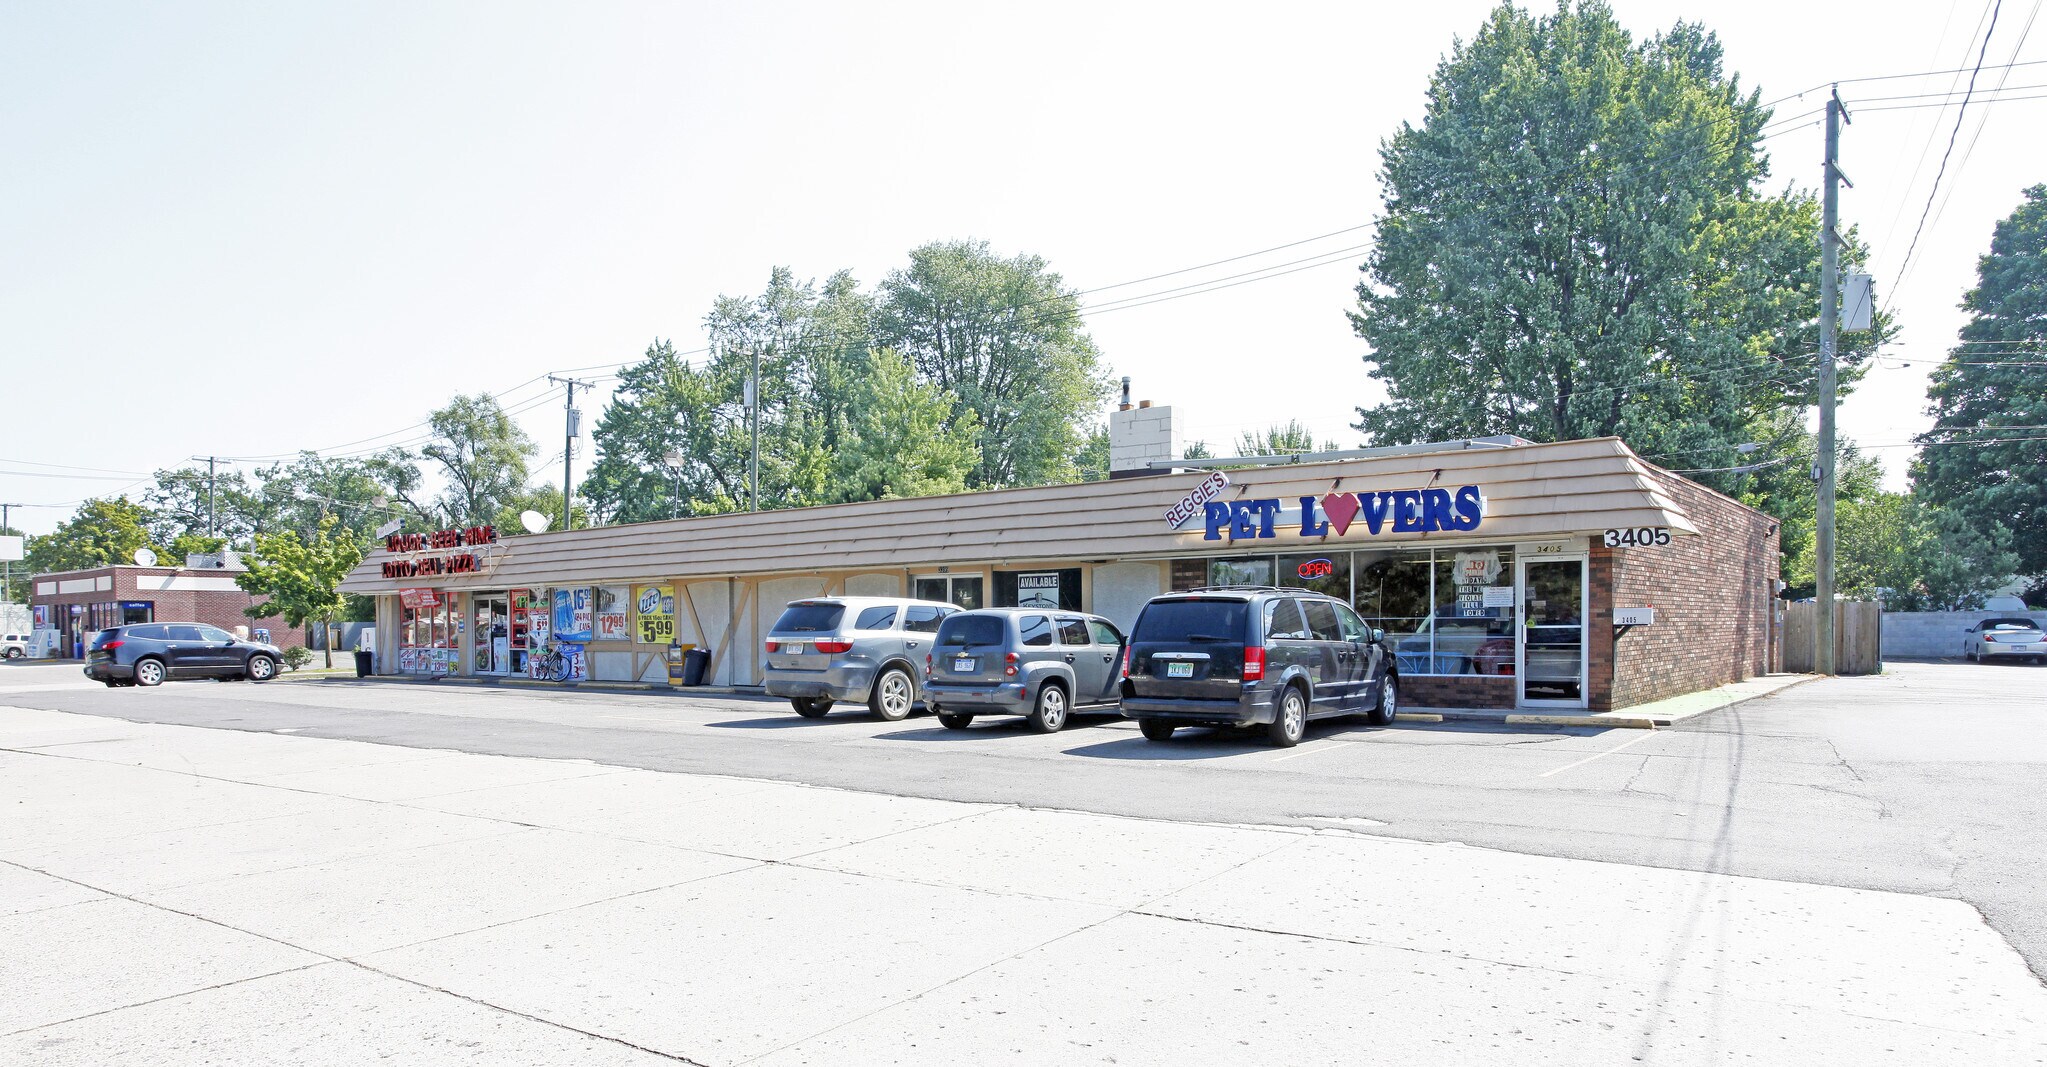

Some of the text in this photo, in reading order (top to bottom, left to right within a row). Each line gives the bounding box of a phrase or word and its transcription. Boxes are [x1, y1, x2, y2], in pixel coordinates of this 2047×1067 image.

[1165, 473, 1225, 527] REGGIE'S
[1204, 498, 1282, 541] PET
[386, 525, 497, 552] LIQUOR BEER WINE
[1605, 528, 1670, 547] 3405
[381, 554, 481, 578] LOTTO DELI PIZZA
[1298, 563, 1332, 576] OPEN
[1020, 576, 1058, 588] AVAILABLE
[1622, 616, 1637, 624] 3405
